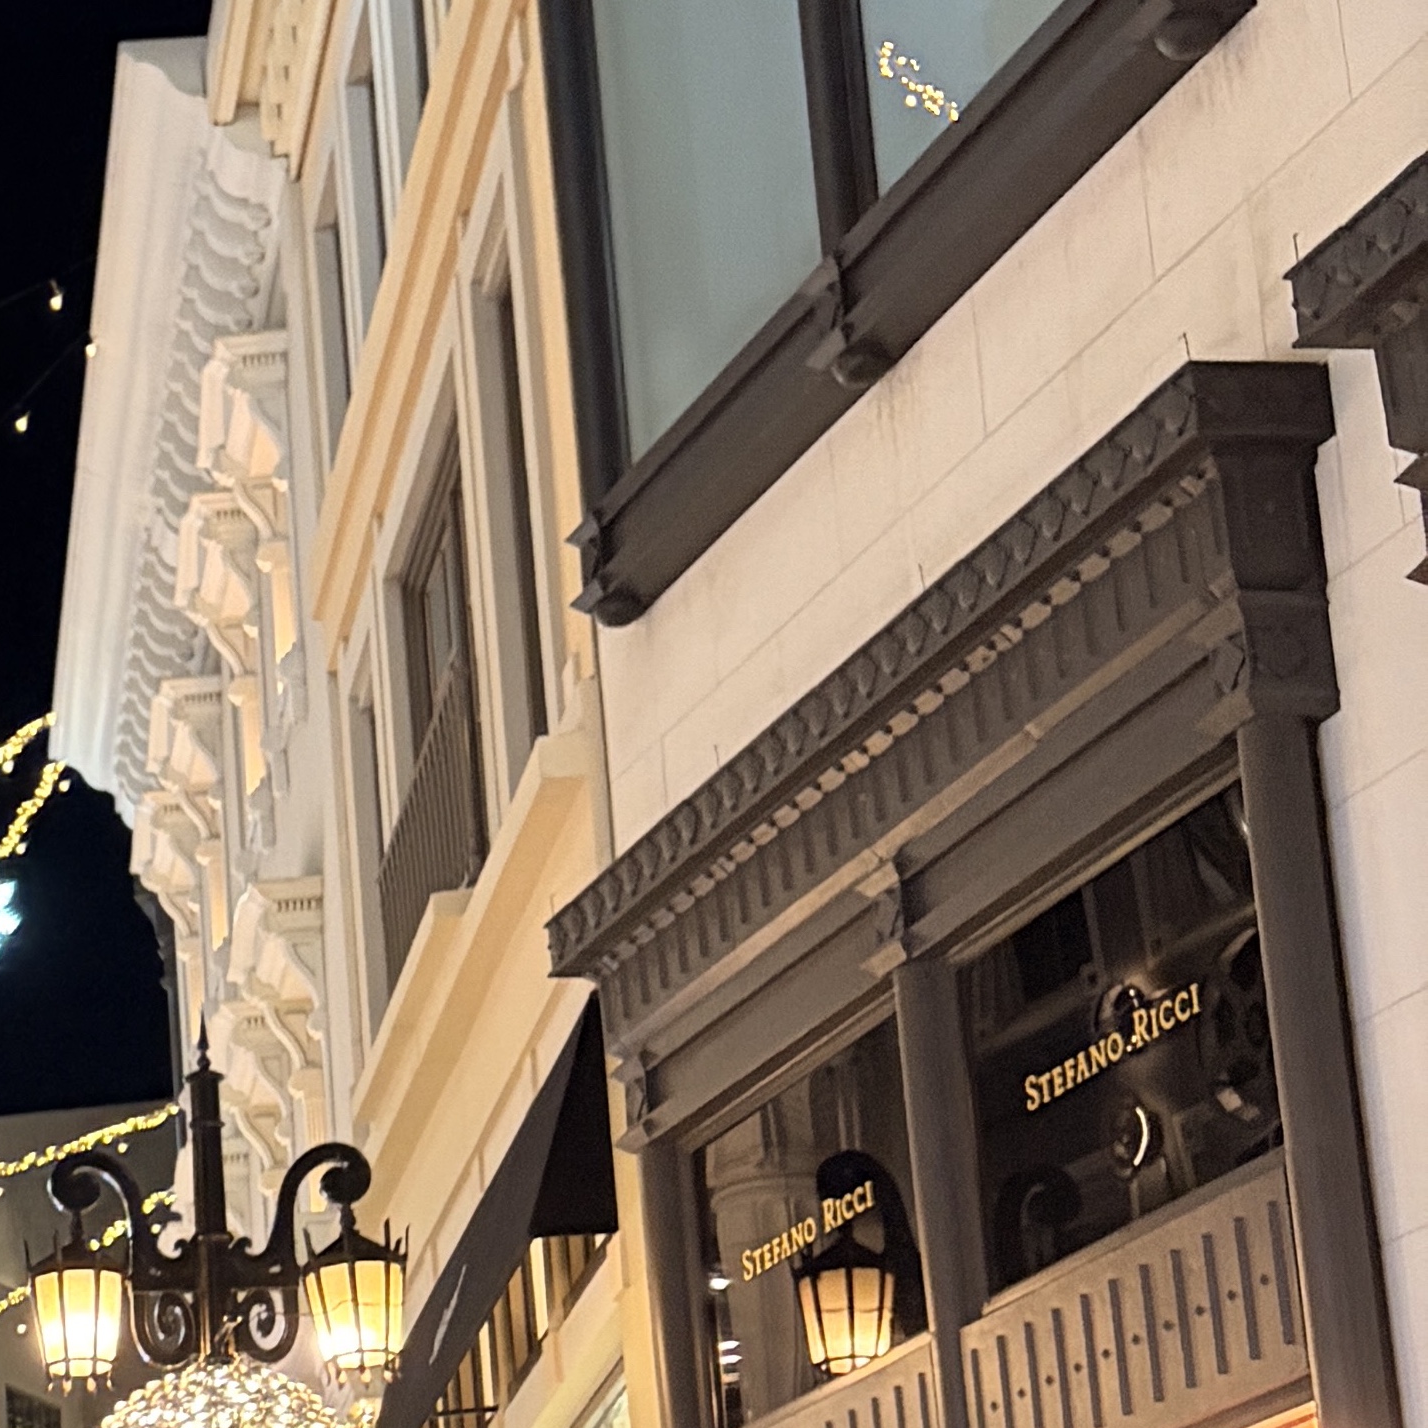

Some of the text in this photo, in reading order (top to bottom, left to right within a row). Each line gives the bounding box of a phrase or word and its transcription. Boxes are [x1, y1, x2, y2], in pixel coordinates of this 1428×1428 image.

[1024, 982, 1201, 1112] STEFANO RICCI
[741, 1181, 875, 1281] STEFANO RICCI
